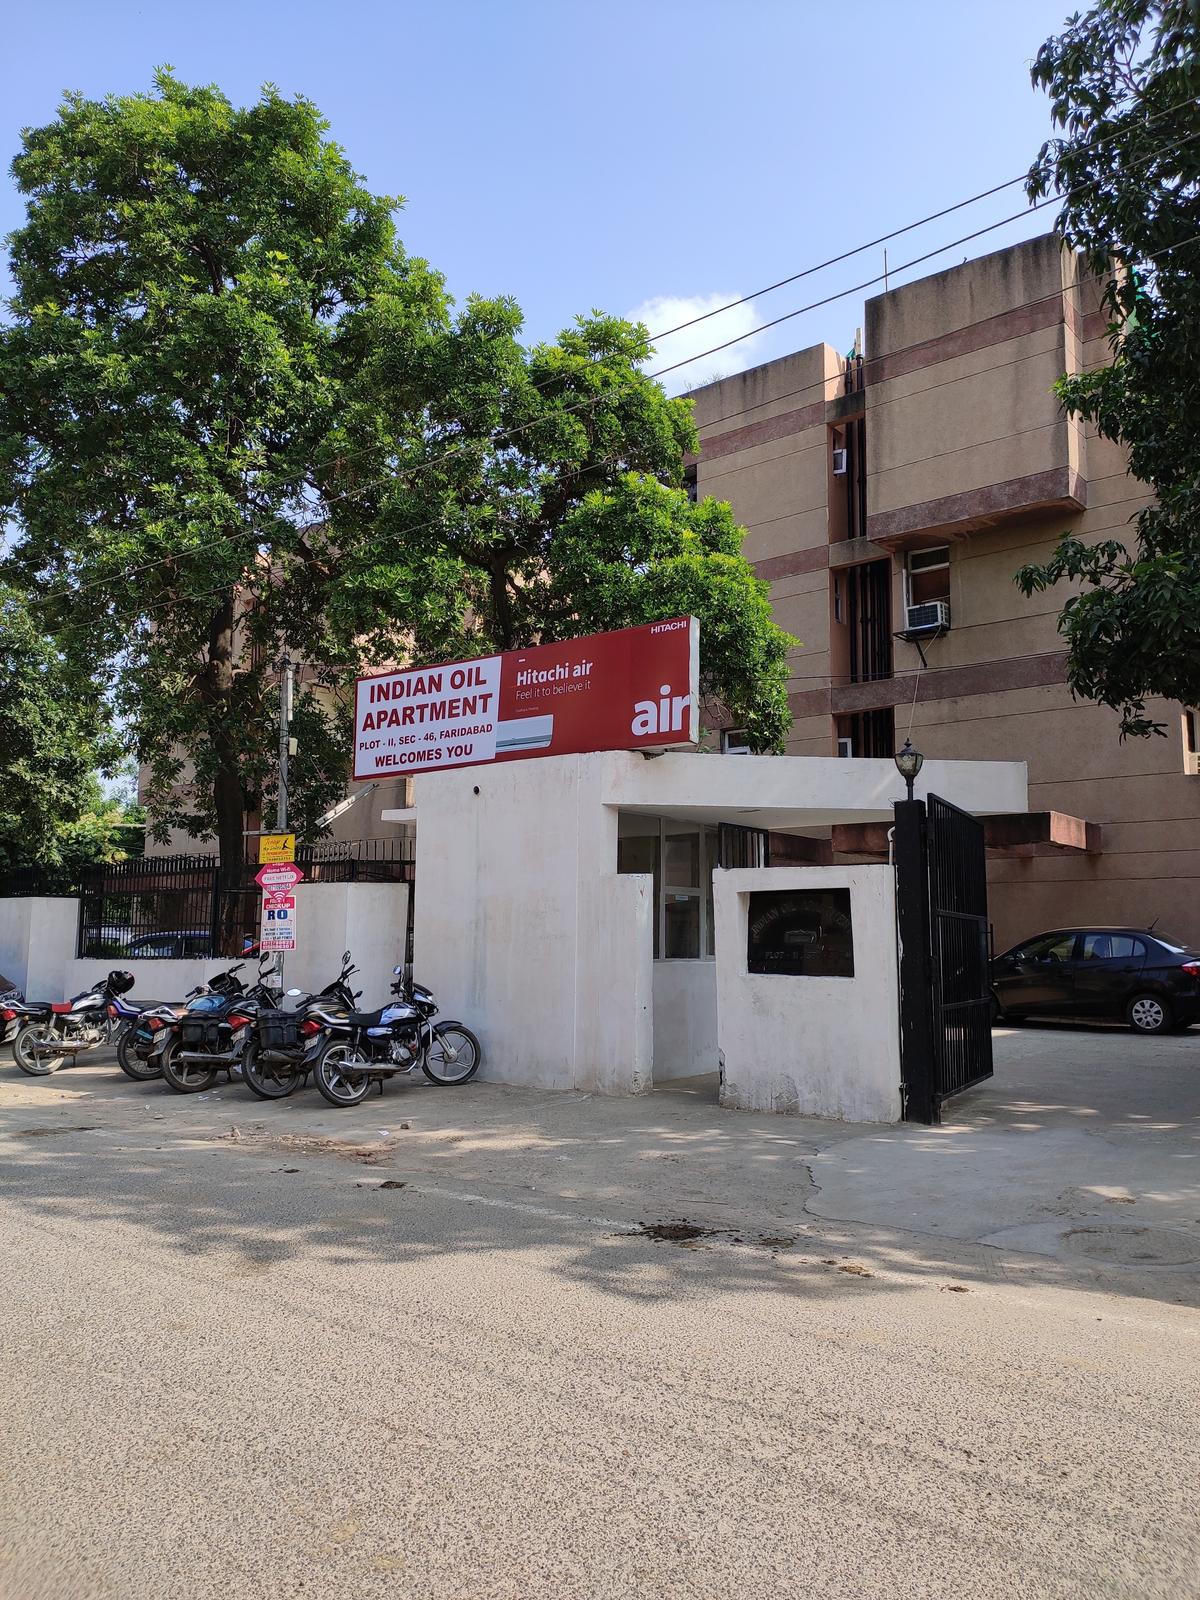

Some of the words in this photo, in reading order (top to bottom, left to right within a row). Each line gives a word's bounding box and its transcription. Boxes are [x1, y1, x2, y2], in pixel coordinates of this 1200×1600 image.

[651, 620, 687, 634] HITACHI
[370, 673, 443, 703] INDIAN
[450, 667, 487, 690] OIL
[516, 662, 569, 686] Hitachi
[573, 659, 594, 678] air
[515, 689, 532, 700] Feel
[534, 688, 540, 698] it
[542, 688, 551, 697] to
[553, 682, 583, 695] believe
[585, 680, 591, 690] it
[362, 693, 493, 731] APARTMENT
[631, 684, 691, 737] air
[359, 740, 381, 751] PLOT
[399, 735, 416, 745] SEC
[424, 732, 437, 742] 46,
[440, 723, 493, 739] FARIDABAD
[375, 748, 442, 767] WELCOMES
[447, 744, 473, 758] YOU
